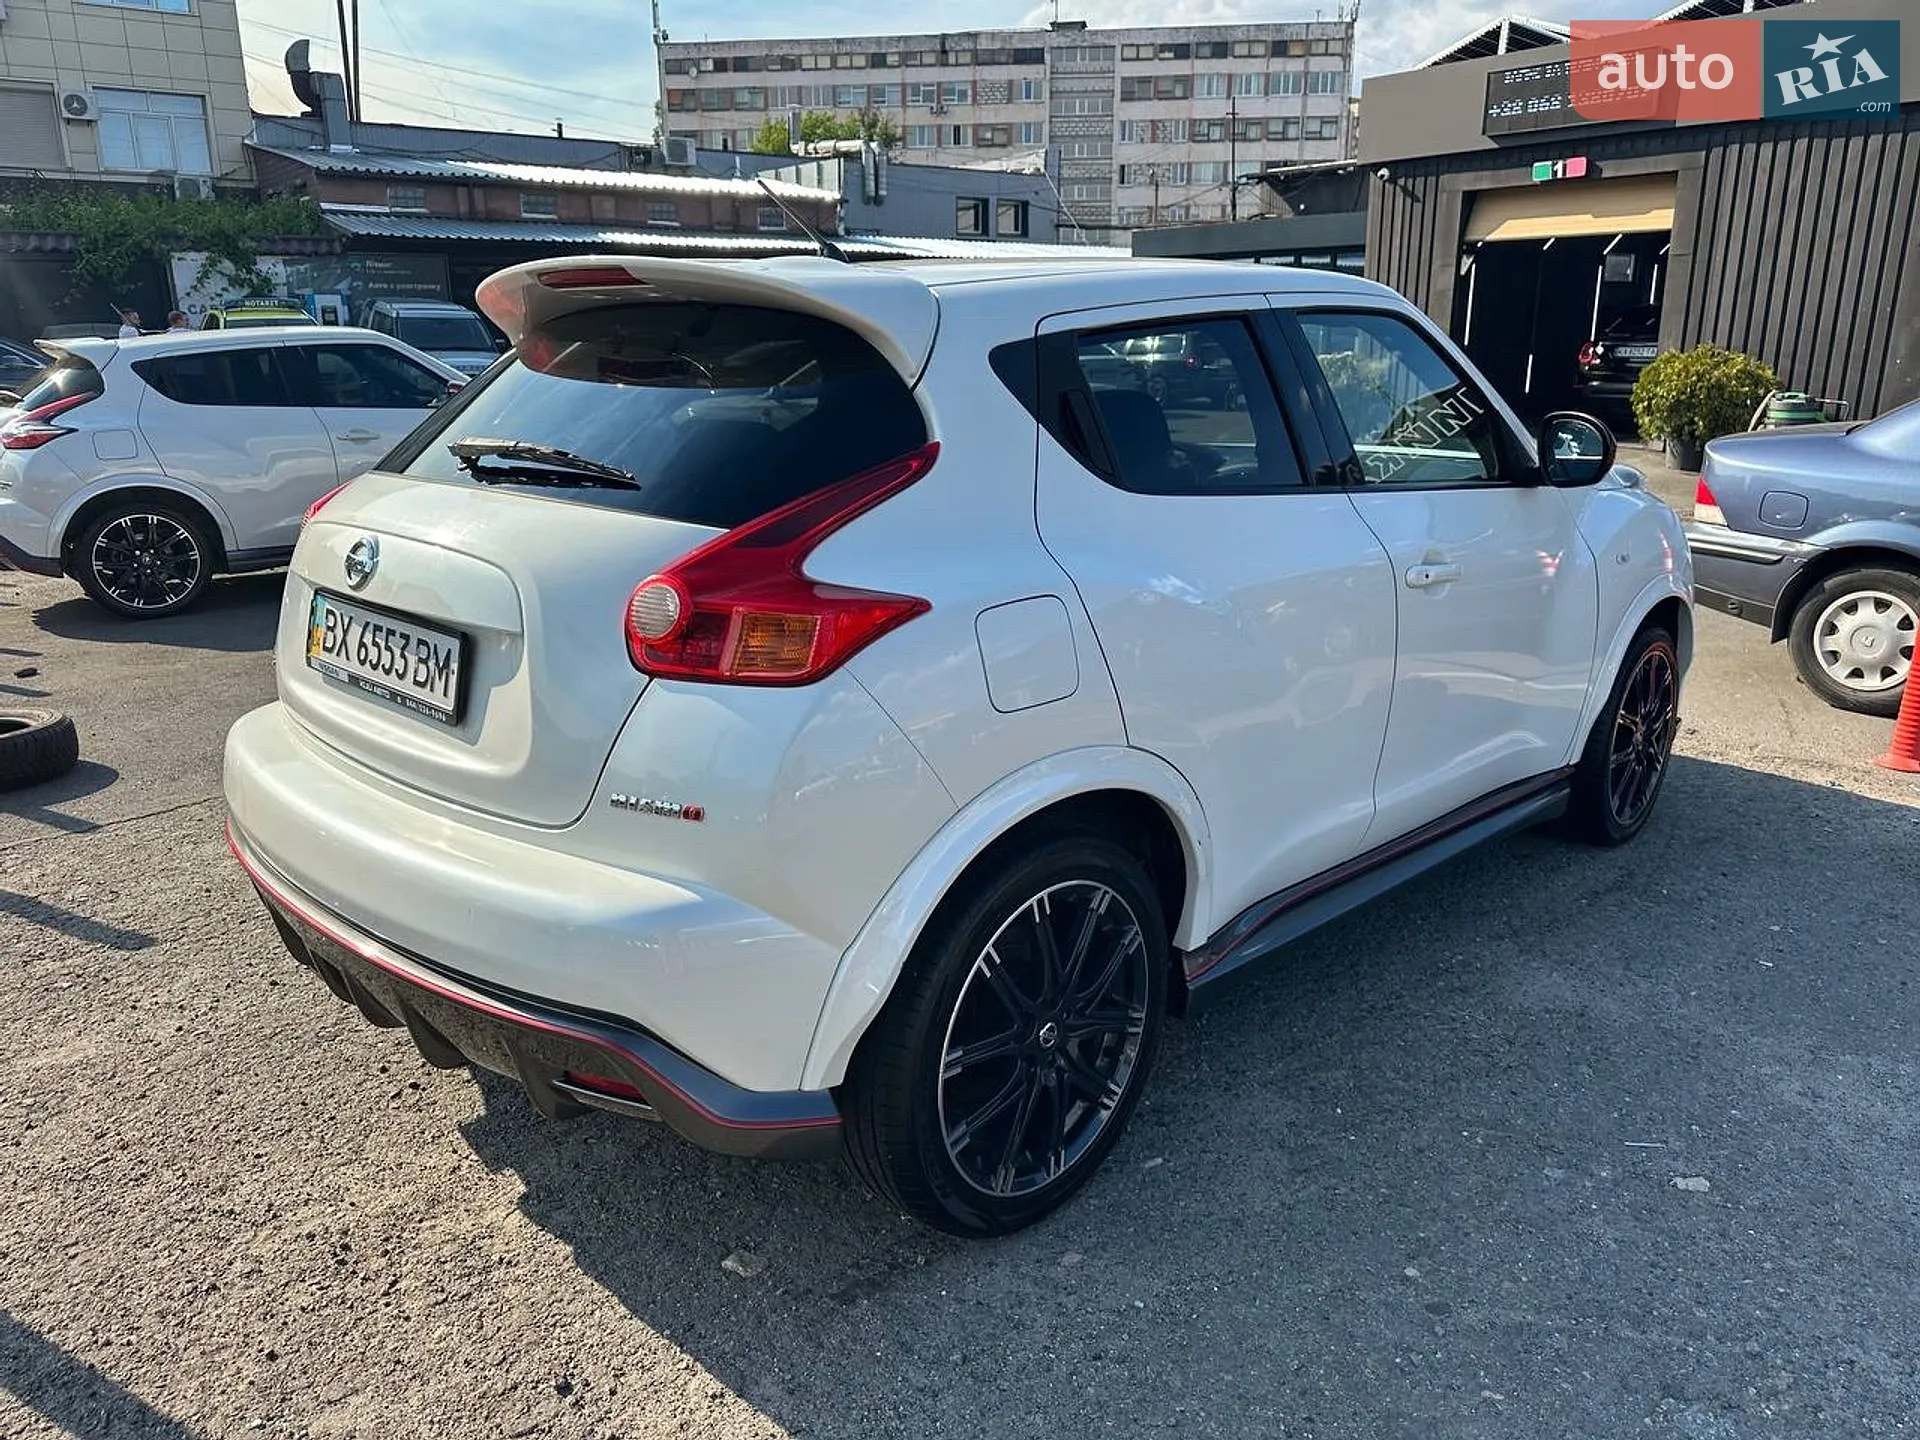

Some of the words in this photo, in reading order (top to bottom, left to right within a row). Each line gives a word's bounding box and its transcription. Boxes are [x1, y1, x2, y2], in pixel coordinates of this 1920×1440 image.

[1553, 160, 1563, 178] 1
[322, 607, 353, 661] BX
[357, 621, 410, 680] 6553
[412, 637, 452, 697] BM
